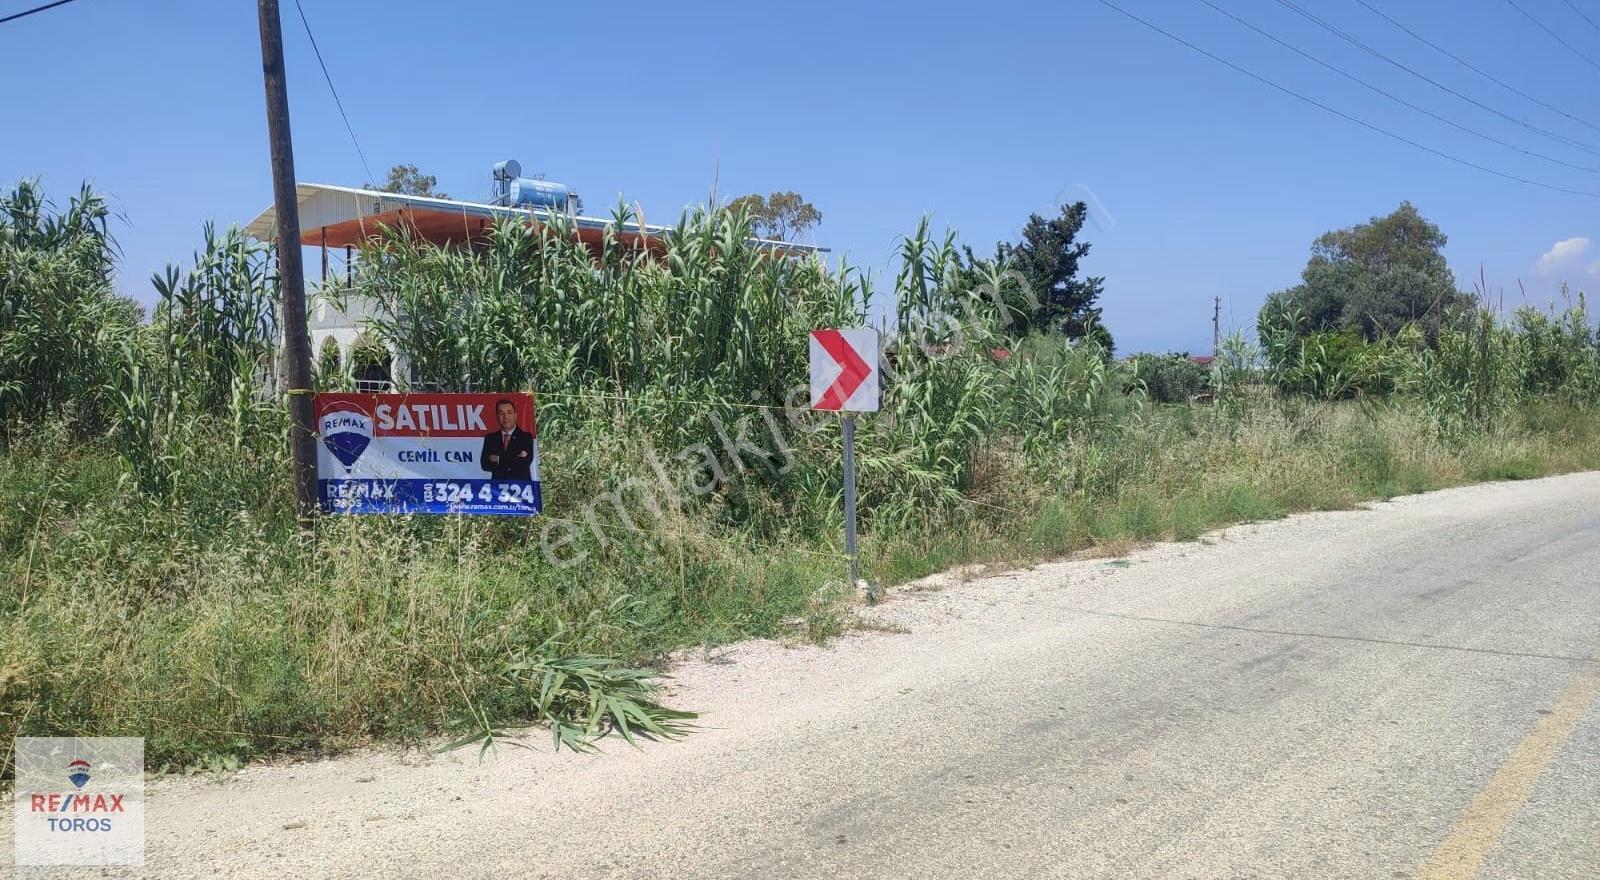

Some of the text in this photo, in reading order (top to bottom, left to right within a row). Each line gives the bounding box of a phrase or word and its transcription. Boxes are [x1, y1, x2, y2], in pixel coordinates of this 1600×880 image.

[324, 417, 366, 431] RE/MAX
[376, 403, 487, 432] SATILIK
[398, 448, 473, 463] CEMİL CAN
[327, 482, 394, 499] RE/MAX
[435, 482, 474, 502] 324
[478, 482, 493, 502] 4
[498, 483, 535, 504] 324
